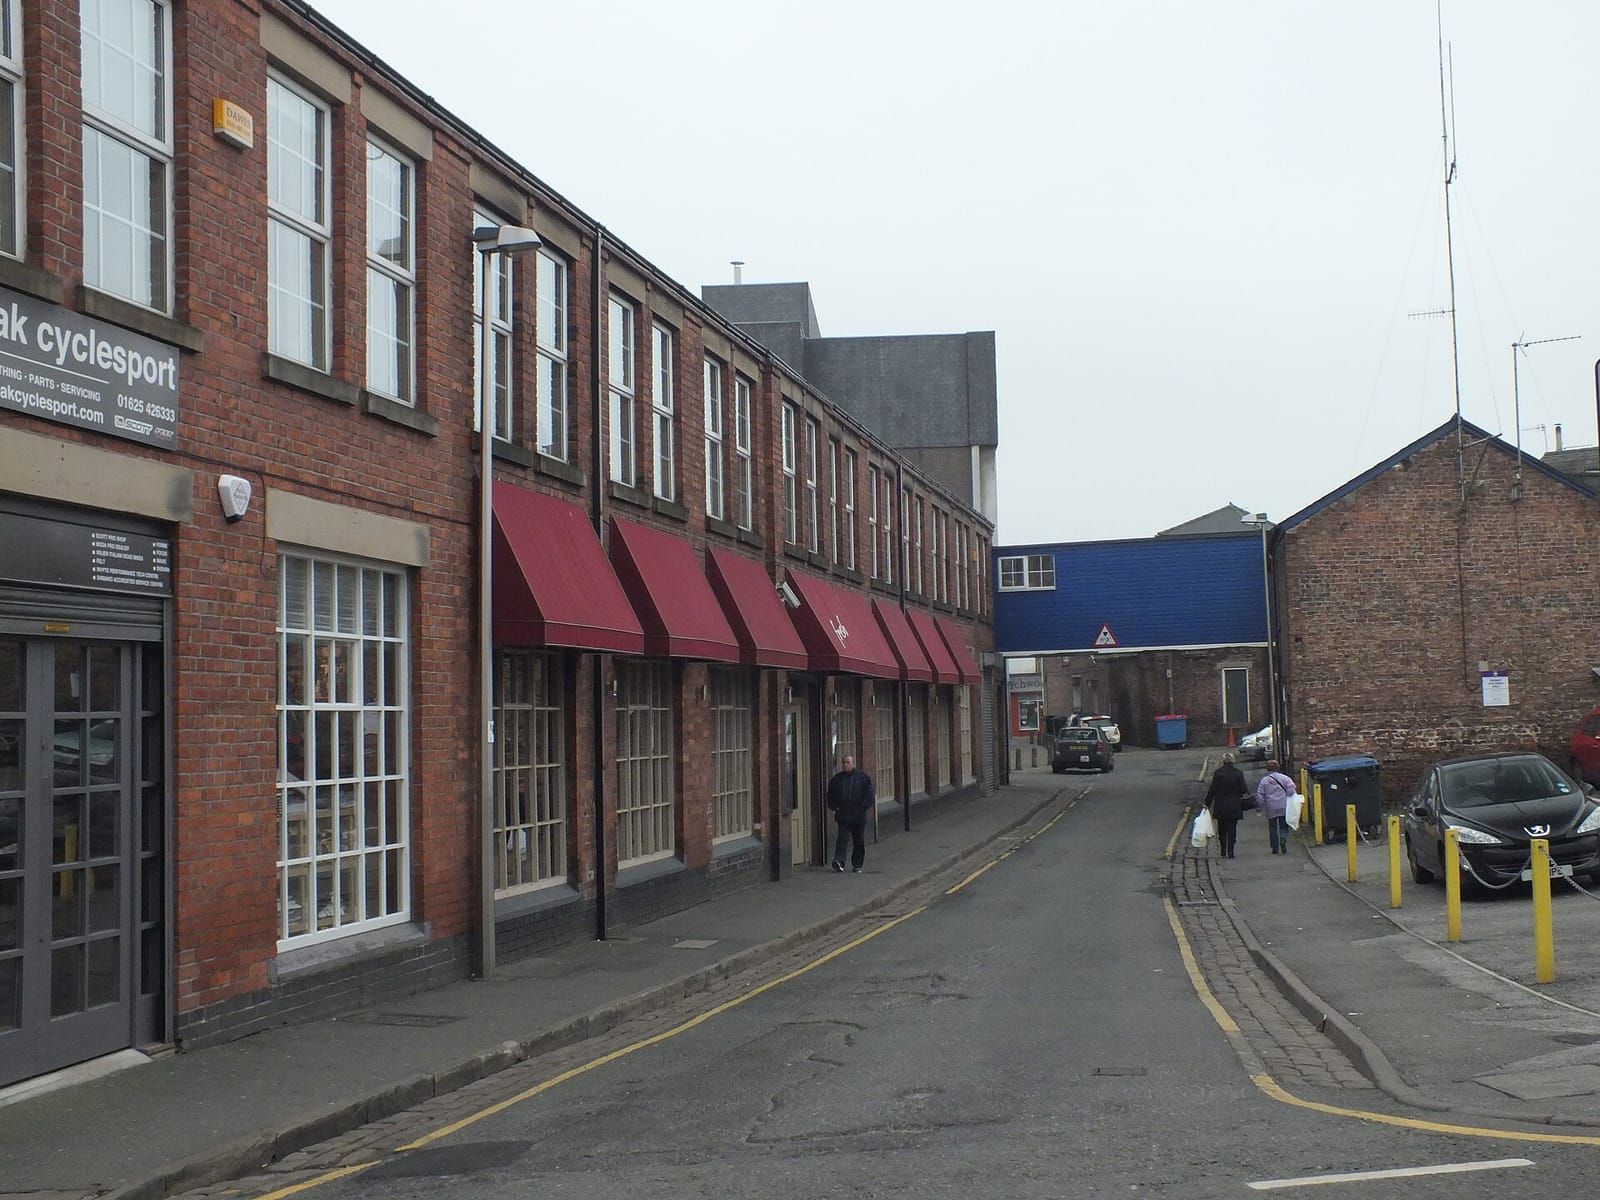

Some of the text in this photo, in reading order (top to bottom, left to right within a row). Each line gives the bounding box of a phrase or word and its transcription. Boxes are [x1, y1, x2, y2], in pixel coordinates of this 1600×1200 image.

[37, 321, 176, 390] cyclesport
[29, 374, 55, 389] PARTS
[61, 382, 101, 401] SERVICING
[0, 385, 104, 424] akcyclesport.com
[117, 394, 175, 422] 01625 426333
